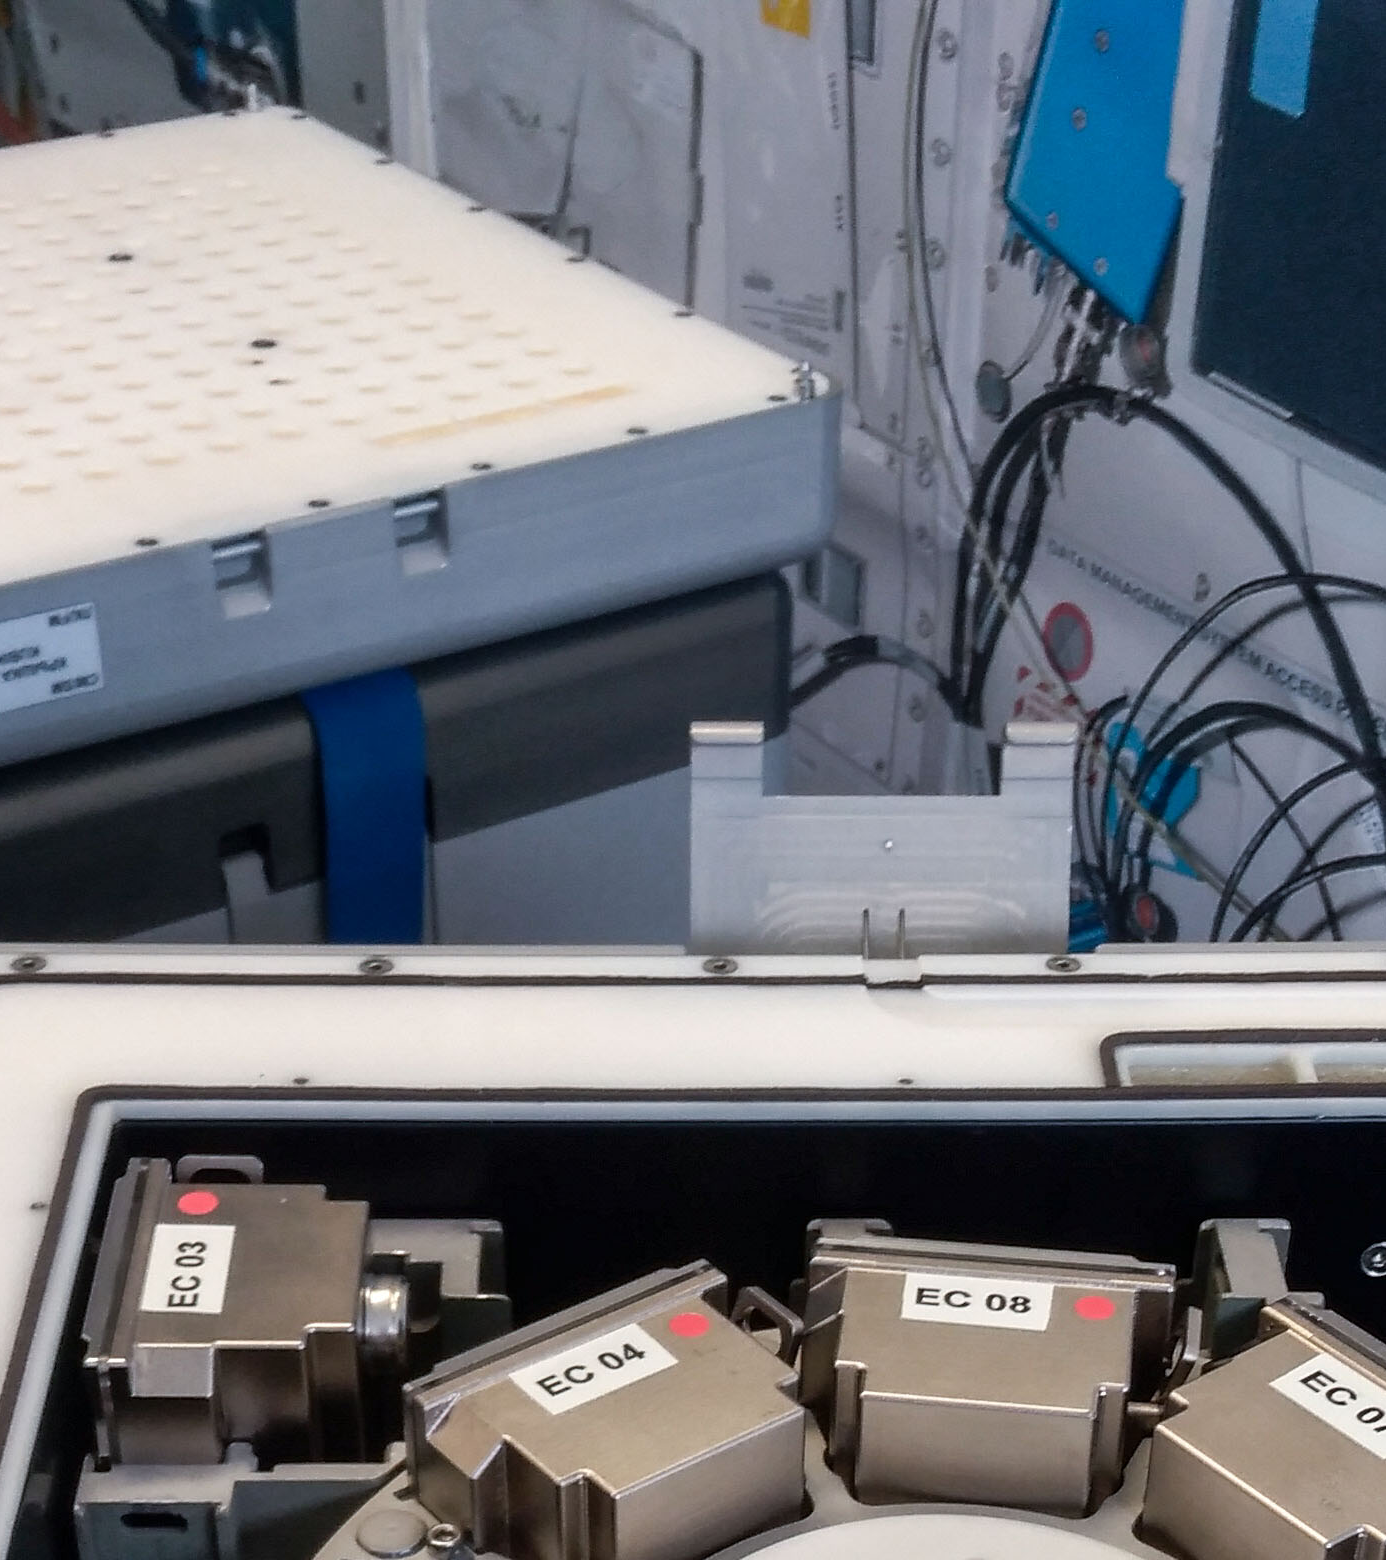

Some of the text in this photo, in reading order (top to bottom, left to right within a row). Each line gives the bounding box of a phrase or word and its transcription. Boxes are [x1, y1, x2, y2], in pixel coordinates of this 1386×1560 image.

[167, 1240, 207, 1309] EC 03
[915, 1287, 1032, 1314] EC 08
[536, 1342, 646, 1398] EC 04
[1298, 1369, 1357, 1407] EC
